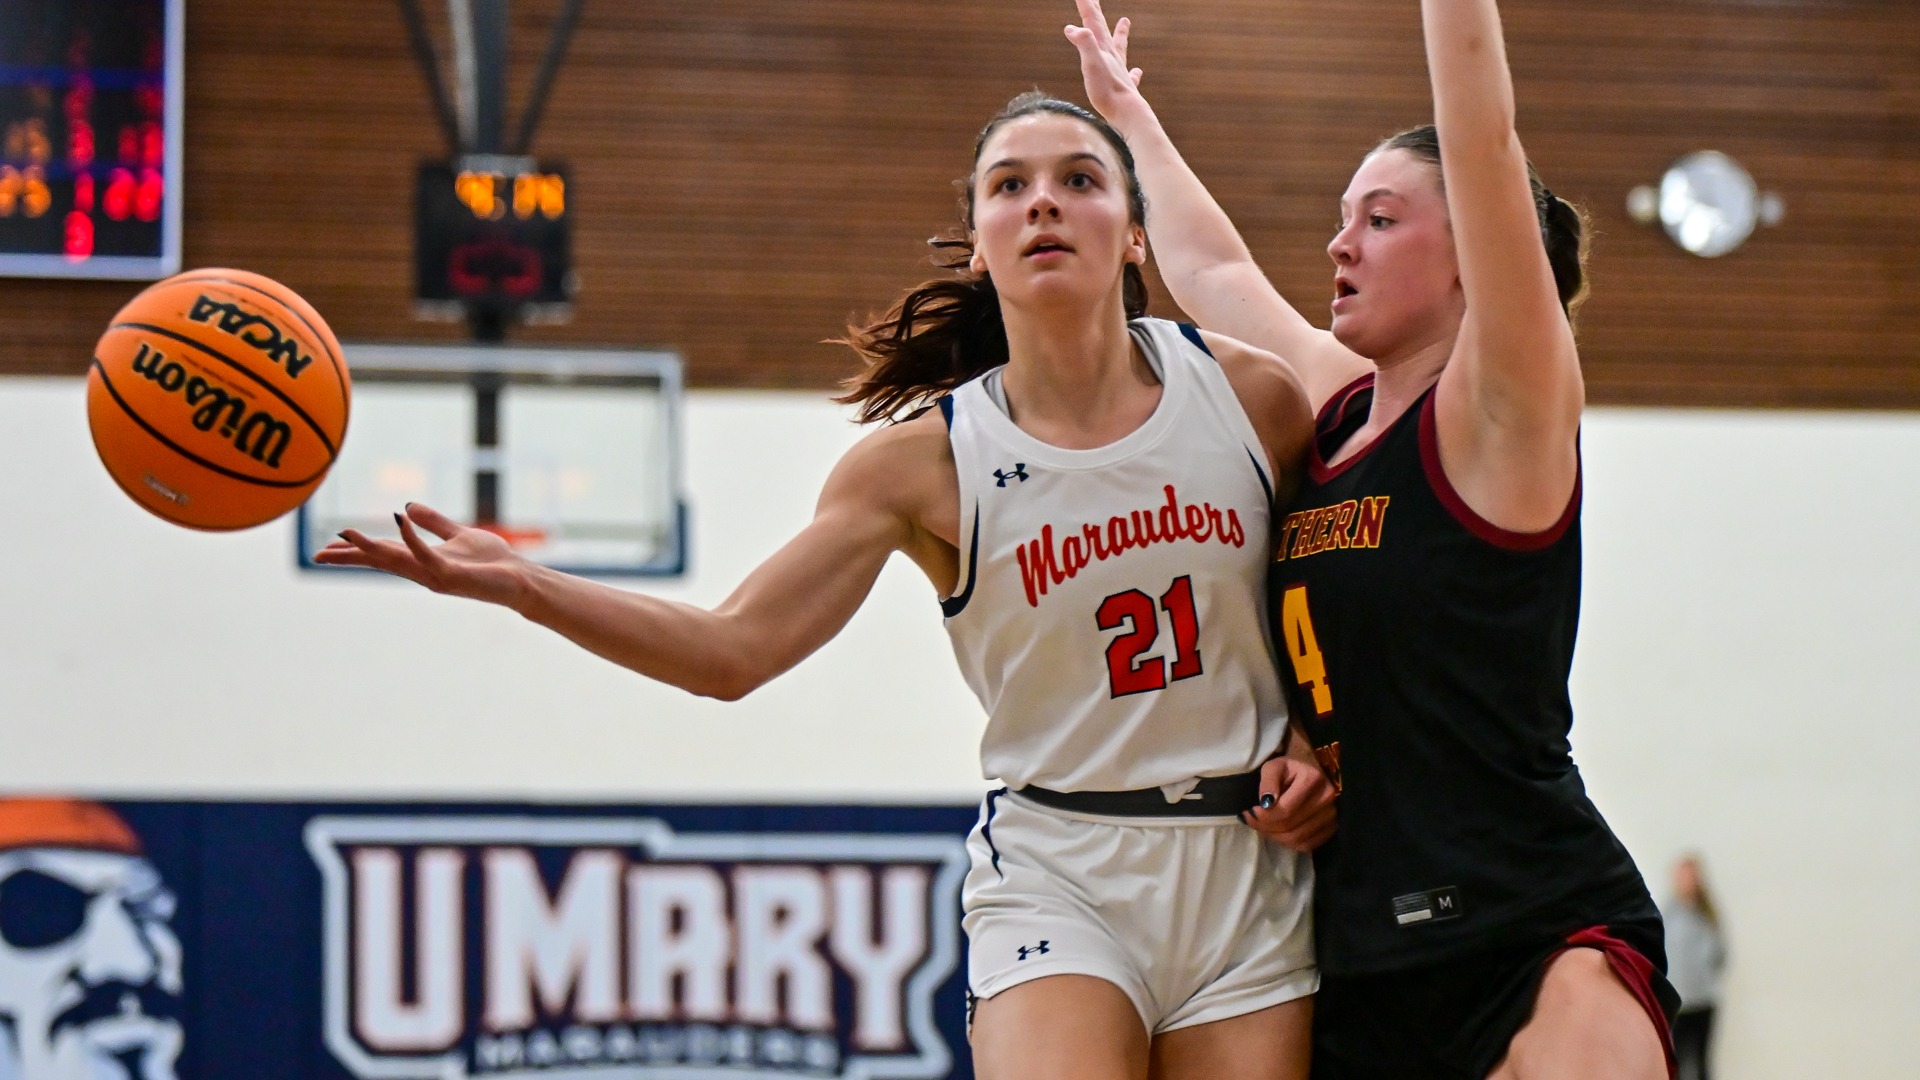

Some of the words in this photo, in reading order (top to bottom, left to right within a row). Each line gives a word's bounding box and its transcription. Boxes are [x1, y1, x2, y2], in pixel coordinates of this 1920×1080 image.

[188, 294, 313, 379] NCAA
[132, 343, 292, 469] Wilson
[1016, 484, 1245, 608] Marauders
[1095, 574, 1204, 700] 21
[1281, 584, 1335, 718] 4
[352, 845, 931, 1052] UMARY
[1438, 896, 1453, 910] M
